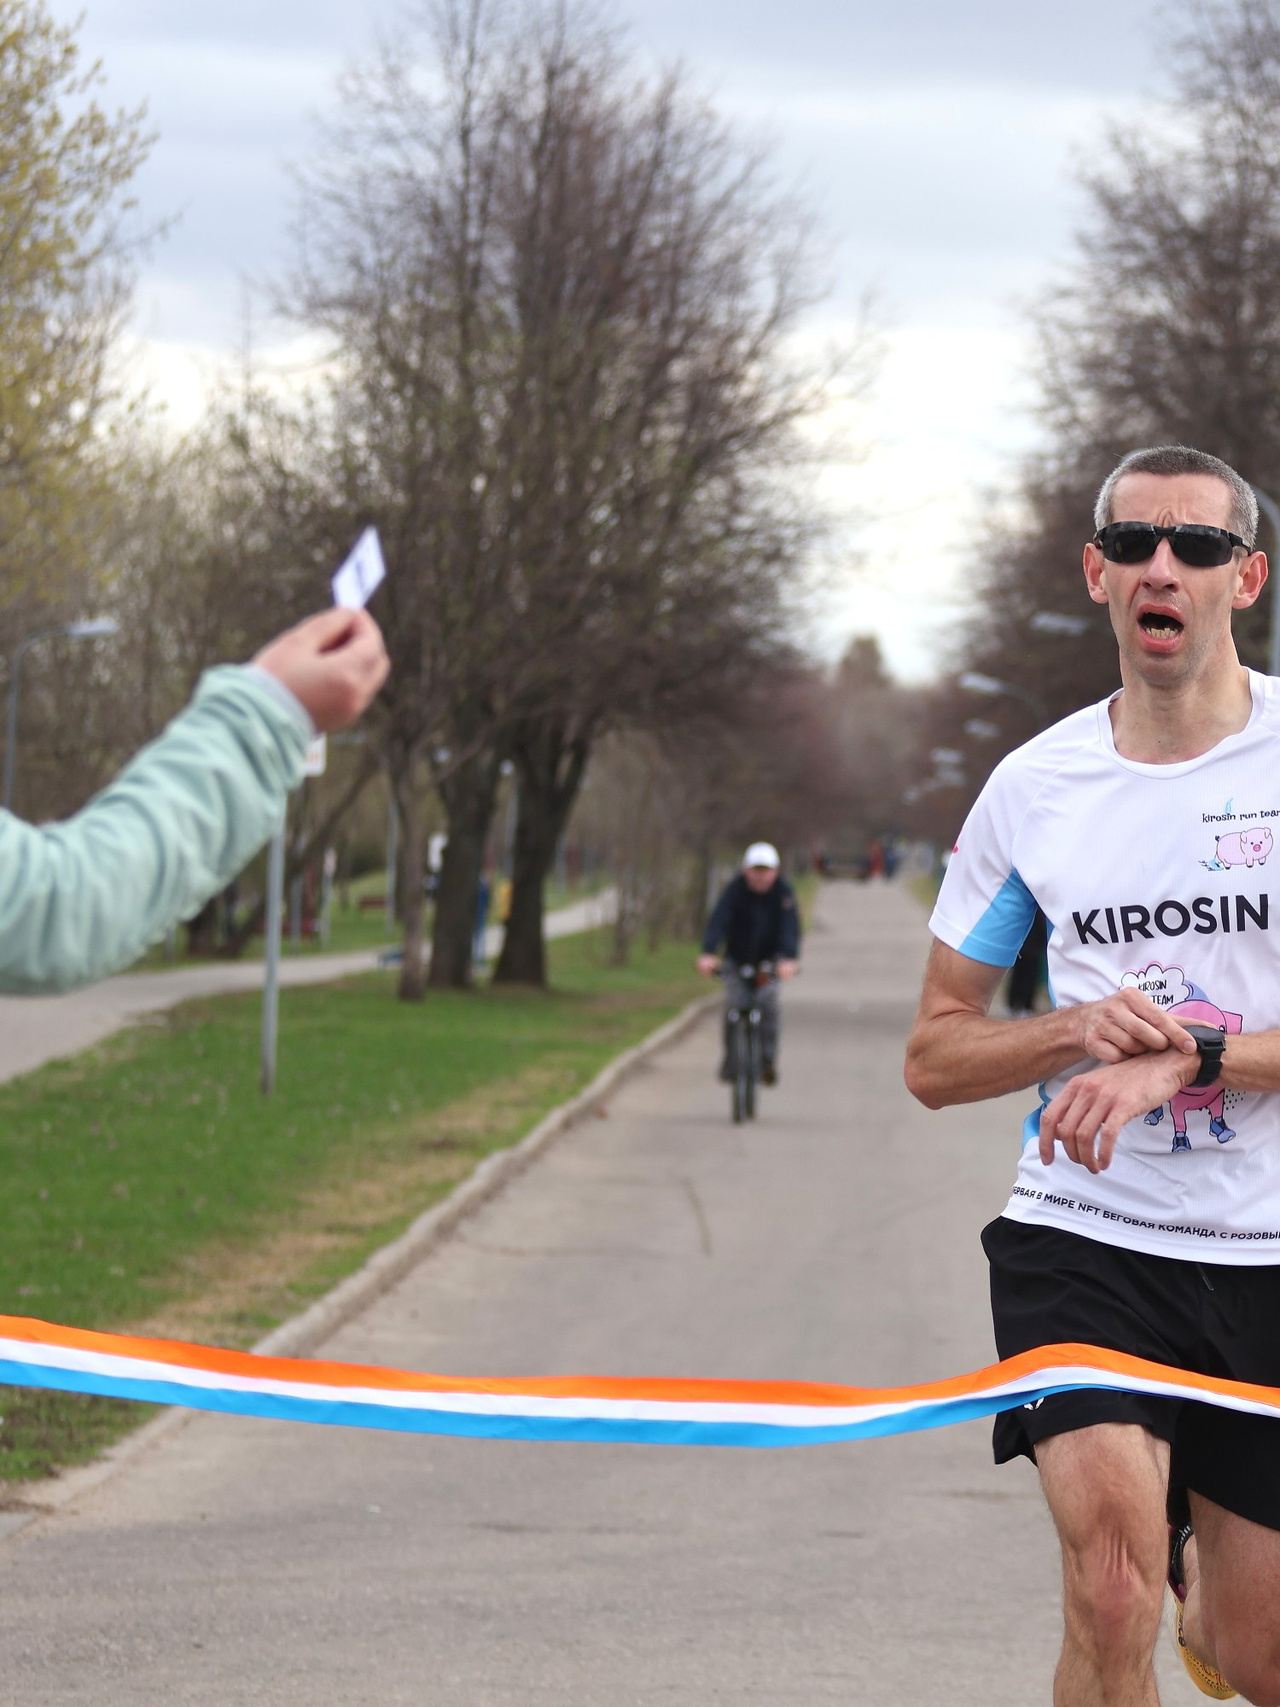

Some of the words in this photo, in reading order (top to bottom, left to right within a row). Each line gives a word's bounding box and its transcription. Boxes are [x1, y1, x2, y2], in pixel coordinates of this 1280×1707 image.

[1202, 812, 1236, 823] kirosin
[1240, 812, 1257, 821] run
[1072, 893, 1269, 945] KIROSIN
[1138, 979, 1167, 992] KIROSIN
[1151, 994, 1174, 1005] TEAM
[1012, 1185, 1037, 1198] ЕРВАЯ
[1036, 1191, 1043, 1200] В
[1043, 1193, 1075, 1209] МИРЕ
[1077, 1202, 1101, 1216] NFT
[1102, 1210, 1155, 1229] БЕГОВАЯ
[1158, 1223, 1216, 1238] КОМАНДА
